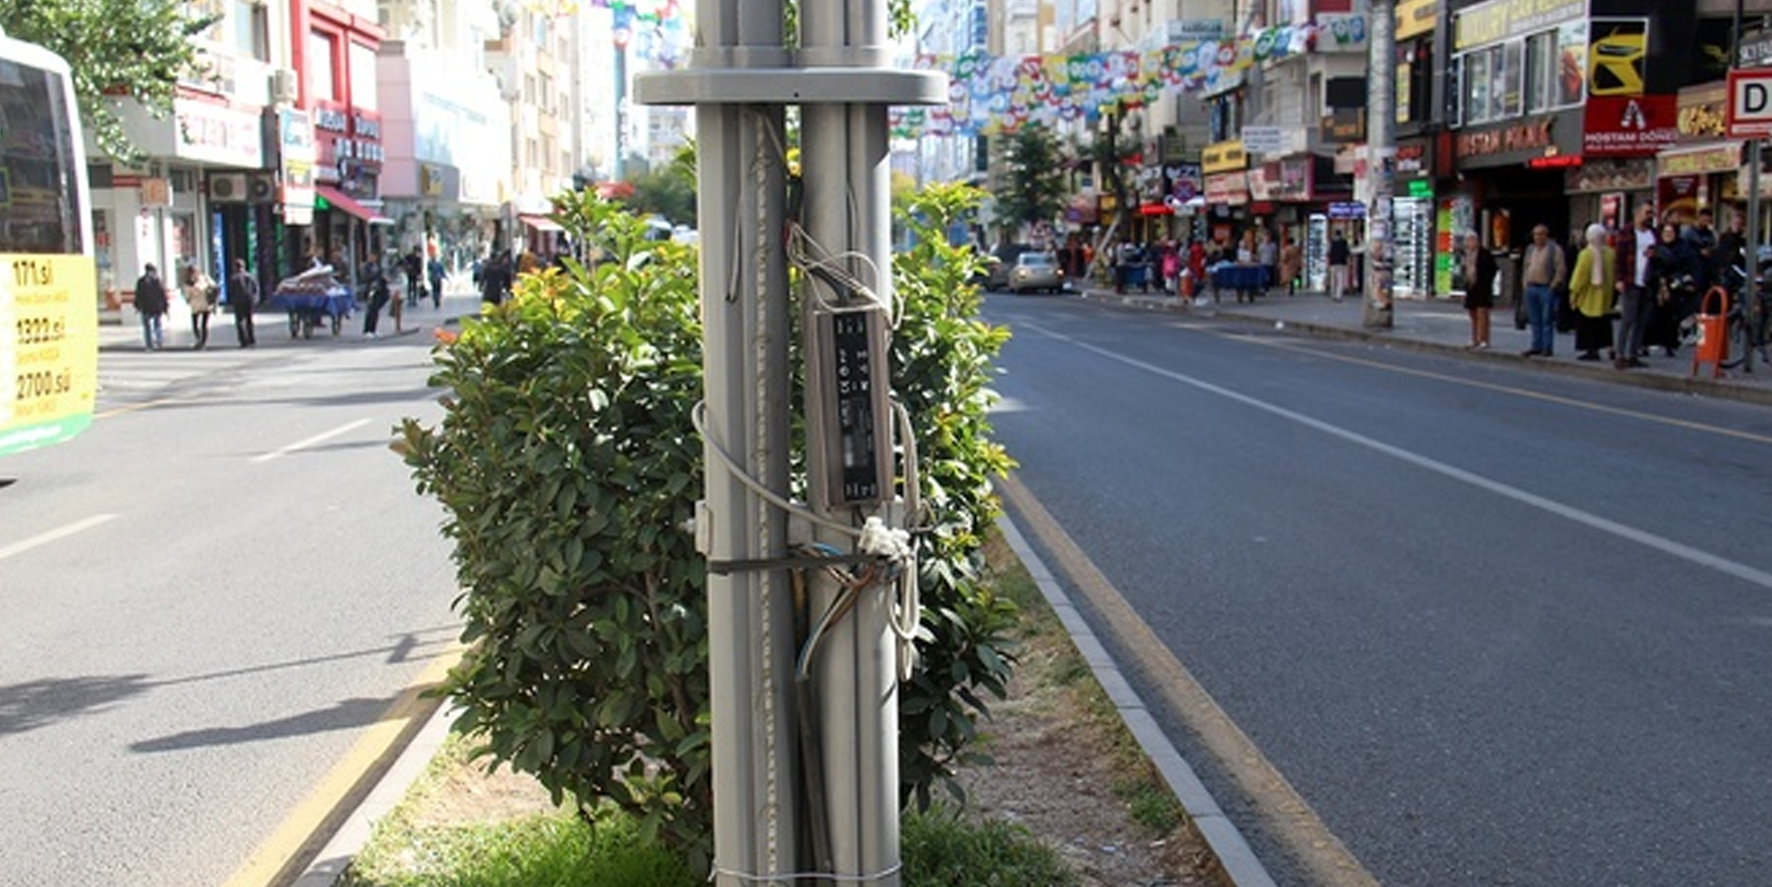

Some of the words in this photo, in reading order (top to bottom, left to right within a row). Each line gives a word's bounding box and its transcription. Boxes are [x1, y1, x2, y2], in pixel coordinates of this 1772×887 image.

[1744, 83, 1768, 113] D
[12, 260, 54, 287] 171.si
[16, 368, 71, 400] 2700.sü
